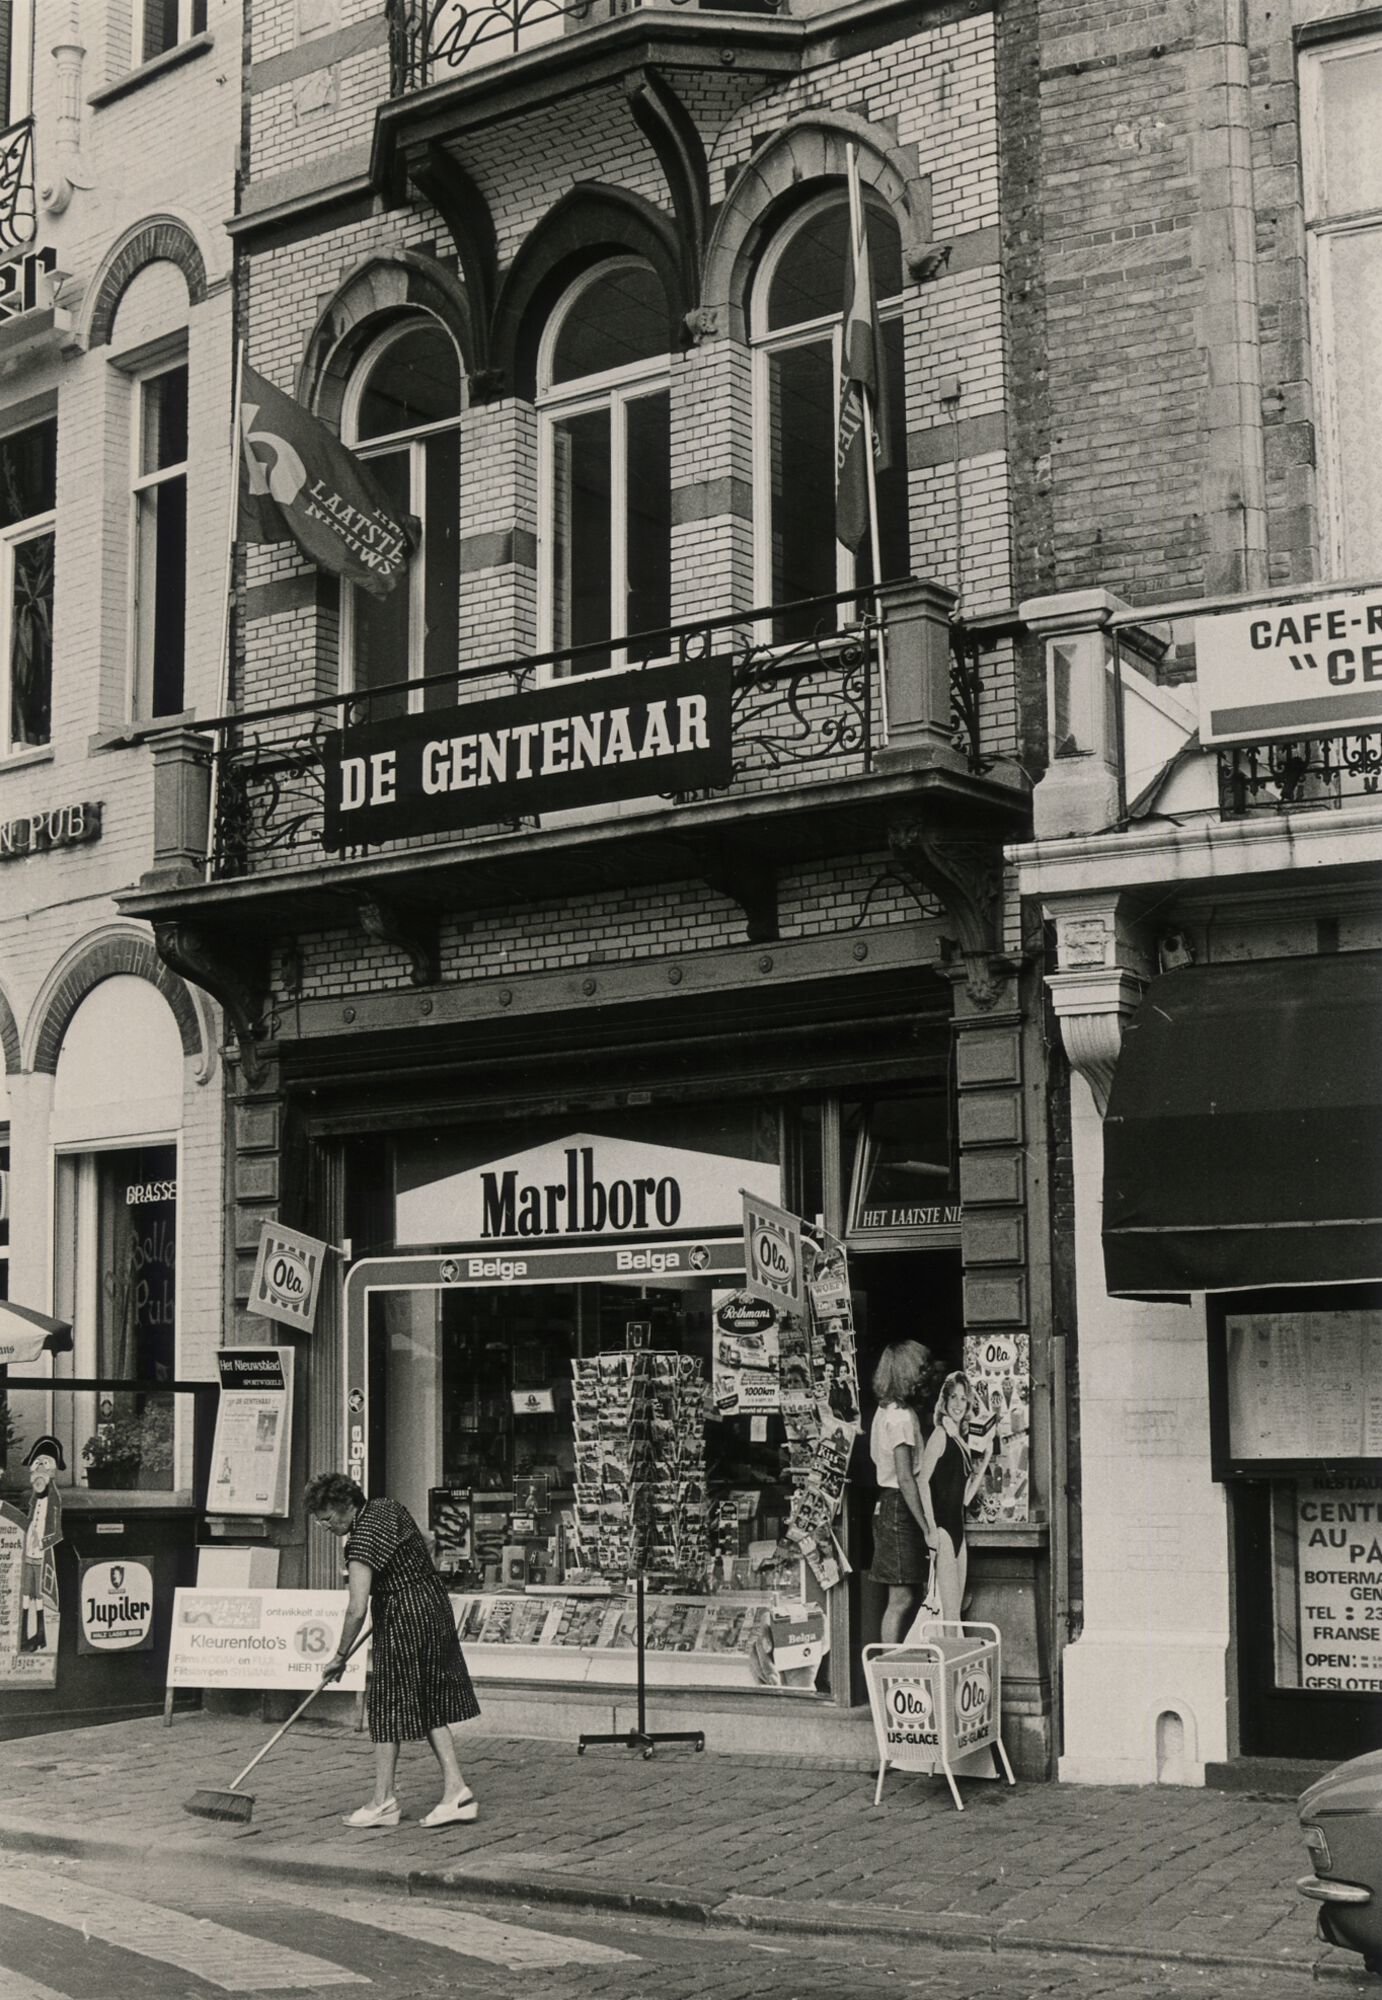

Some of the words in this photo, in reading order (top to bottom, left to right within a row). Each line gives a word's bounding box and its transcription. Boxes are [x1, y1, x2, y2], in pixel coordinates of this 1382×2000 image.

[310, 479, 404, 564] LAATSTE
[340, 751, 396, 811] DE
[422, 694, 710, 795] GENTENAAR
[30, 804, 84, 850] PUB
[480, 1147, 681, 1238] Marlboro
[863, 1210, 888, 1227] HET
[891, 1207, 941, 1225] LAATSTE
[616, 1249, 680, 1273] Belga
[760, 1235, 789, 1274] Ola
[274, 1259, 304, 1294] Ola
[468, 1259, 528, 1281] Belga
[722, 1305, 771, 1320] Rothmans
[986, 1343, 1010, 1363] Ola
[220, 1360, 233, 1371] Het
[235, 1360, 281, 1371] Nieuwsblad
[745, 1386, 775, 1397] 1000km
[349, 1425, 364, 1487] elga
[1308, 1528, 1347, 1547] AU
[1350, 1586, 1382, 1601] GEN
[86, 1596, 150, 1629] Jupiler
[1305, 1605, 1336, 1620] TEL
[190, 1634, 287, 1650] Kleurenfoto's
[789, 1633, 816, 1645] Belga
[1313, 1626, 1380, 1641] FRANSE
[288, 1663, 312, 1673] HIER
[894, 1690, 926, 1714] Ola
[961, 1681, 987, 1713] Ola
[888, 1732, 939, 1745] IJS-GLACE
